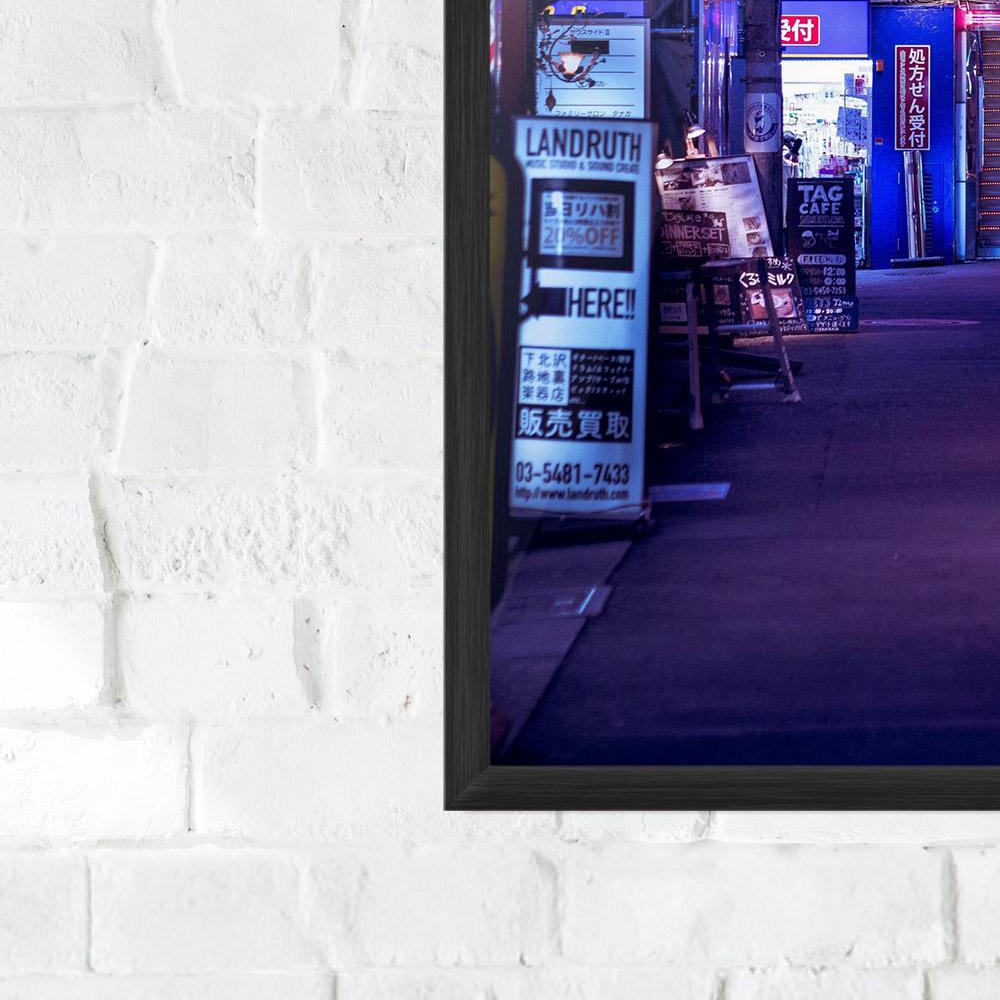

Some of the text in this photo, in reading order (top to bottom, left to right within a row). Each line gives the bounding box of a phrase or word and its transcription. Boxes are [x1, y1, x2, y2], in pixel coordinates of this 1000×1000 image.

[908, 47, 926, 147] 処方せん受付
[526, 127, 642, 162] LANDRUTH
[798, 185, 843, 203] TAG
[799, 202, 841, 214] CAFE
[568, 287, 636, 320] HERE!!
[524, 352, 567, 369] 下北沢
[523, 368, 566, 385] 路地裏
[522, 385, 565, 402] 楽器店
[518, 407, 631, 440] 販売買取
[515, 461, 630, 486] 03-5481-7433
[515, 487, 630, 502] http://www.landruth.com
